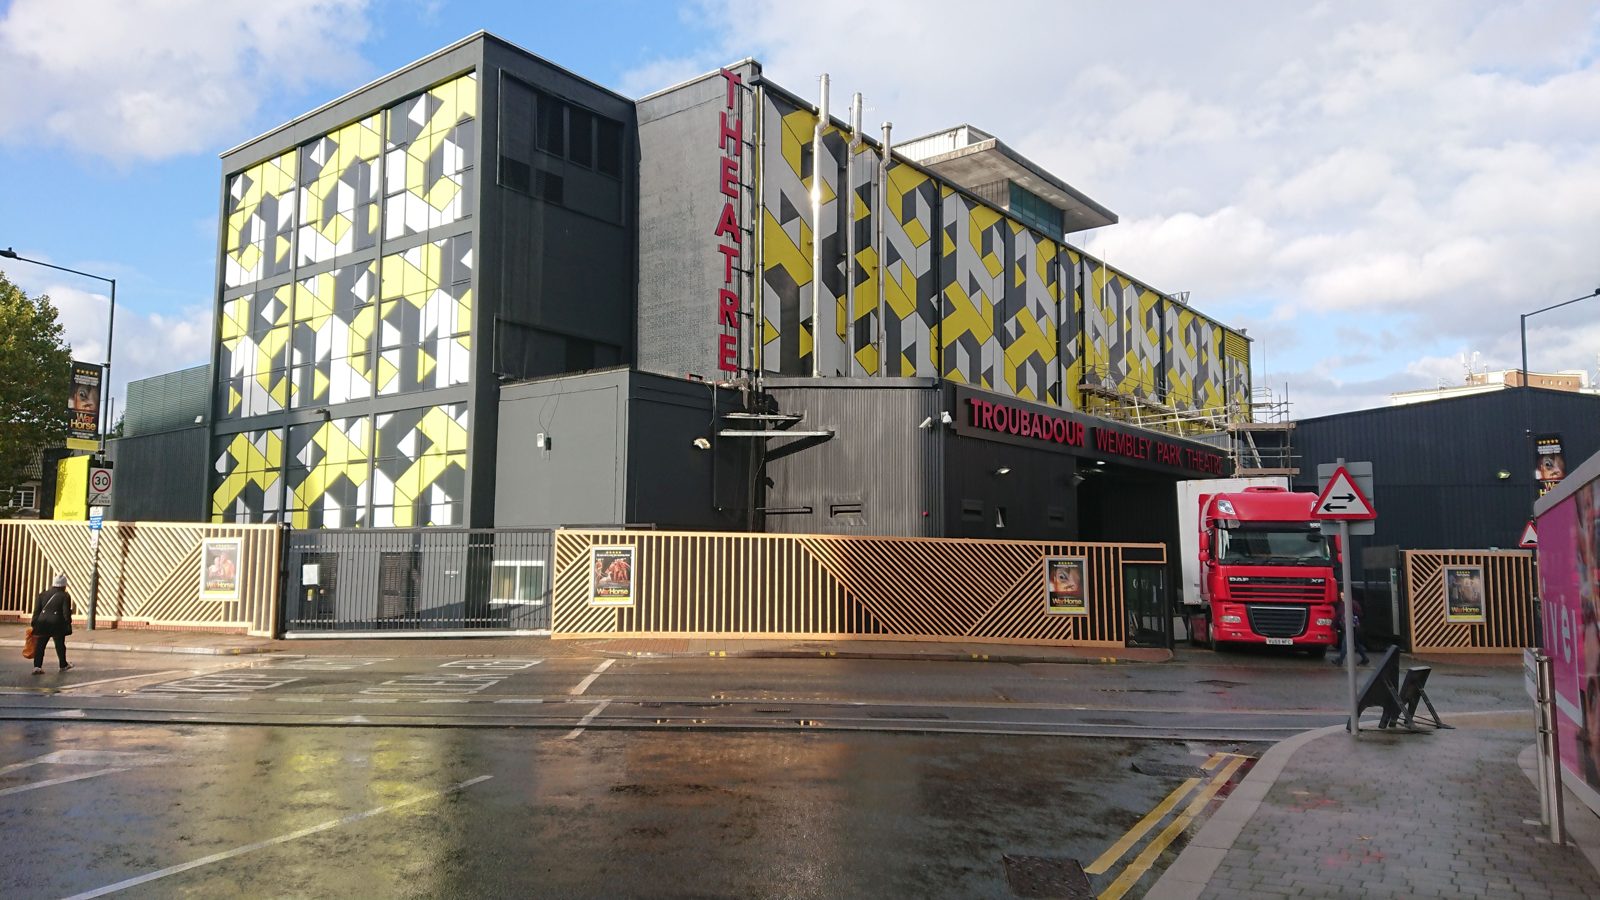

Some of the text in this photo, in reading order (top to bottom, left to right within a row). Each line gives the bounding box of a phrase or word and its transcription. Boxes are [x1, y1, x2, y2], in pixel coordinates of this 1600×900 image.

[715, 68, 741, 372] THEATRE
[76, 412, 95, 423] War
[70, 419, 96, 431] Horse
[971, 398, 1223, 475] TROUBADOUR WEMBLEY PARK THEATRE
[95, 477, 108, 485] 30
